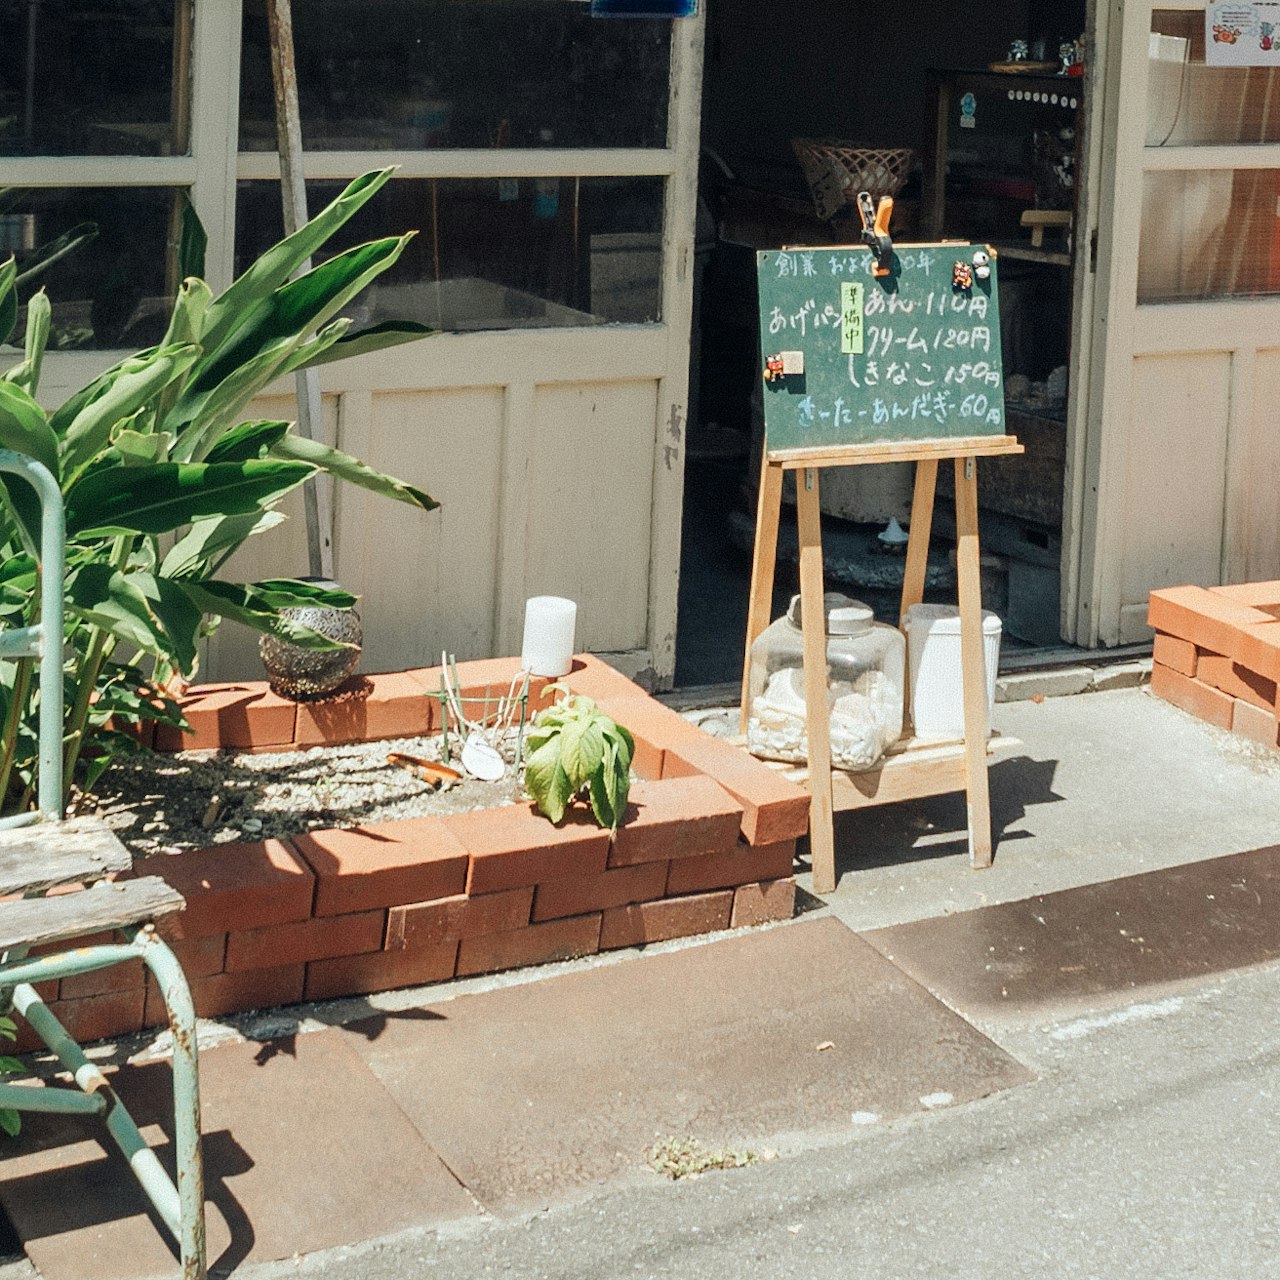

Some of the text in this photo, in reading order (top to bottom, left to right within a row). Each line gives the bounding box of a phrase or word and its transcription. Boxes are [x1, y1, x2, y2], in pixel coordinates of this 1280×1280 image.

[933, 325, 991, 354] 120円
[863, 361, 935, 387] きなこ
